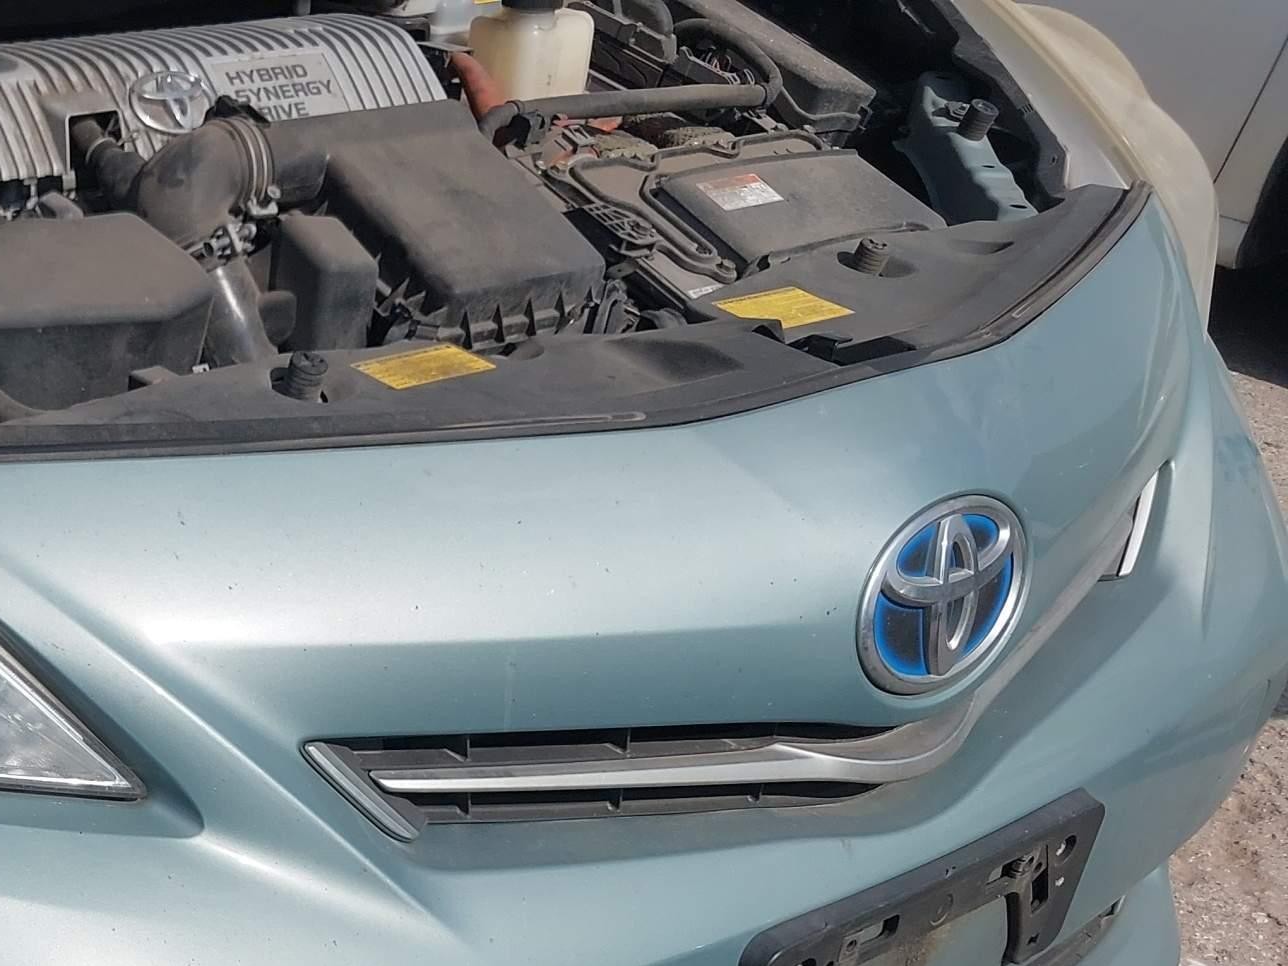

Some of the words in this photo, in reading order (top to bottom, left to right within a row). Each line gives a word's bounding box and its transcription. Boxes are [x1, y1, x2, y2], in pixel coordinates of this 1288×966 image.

[224, 63, 309, 86] HYBRID
[233, 79, 333, 104] SYNERGY
[258, 101, 310, 121] RIVE
